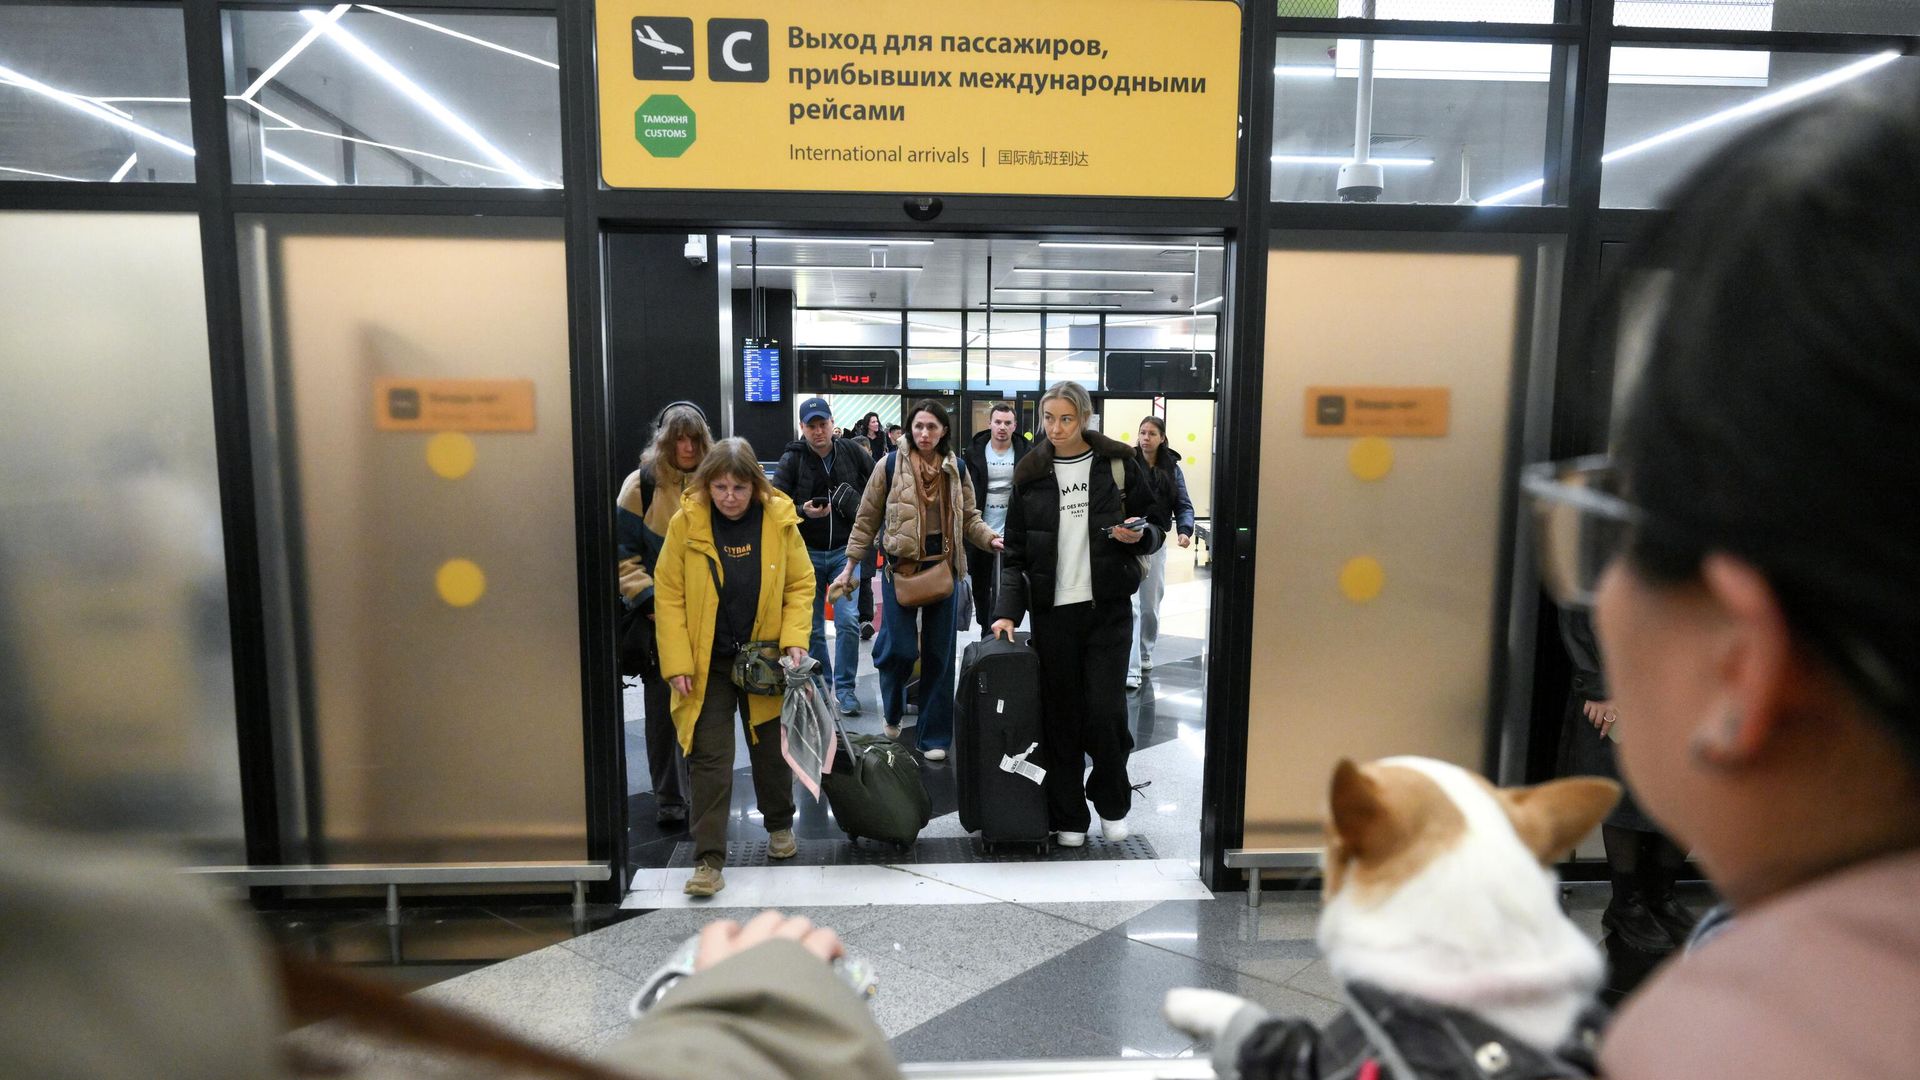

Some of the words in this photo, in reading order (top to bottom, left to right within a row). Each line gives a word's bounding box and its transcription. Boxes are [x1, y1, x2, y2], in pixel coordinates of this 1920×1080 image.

[722, 31, 752, 72] C
[788, 26, 876, 55] Выход
[883, 34, 932, 55] для
[941, 35, 1108, 60] пассажиров,
[788, 62, 952, 89] прибывших
[959, 70, 1206, 96] международными
[642, 114, 688, 124] ТАМОЖНЯ
[789, 98, 905, 124] рейсами
[644, 129, 687, 138] CUSTOMS
[789, 144, 902, 162] International
[907, 147, 970, 164] arrivals
[998, 150, 1089, 167] 国际航班到达
[1061, 483, 1088, 496] MAR
